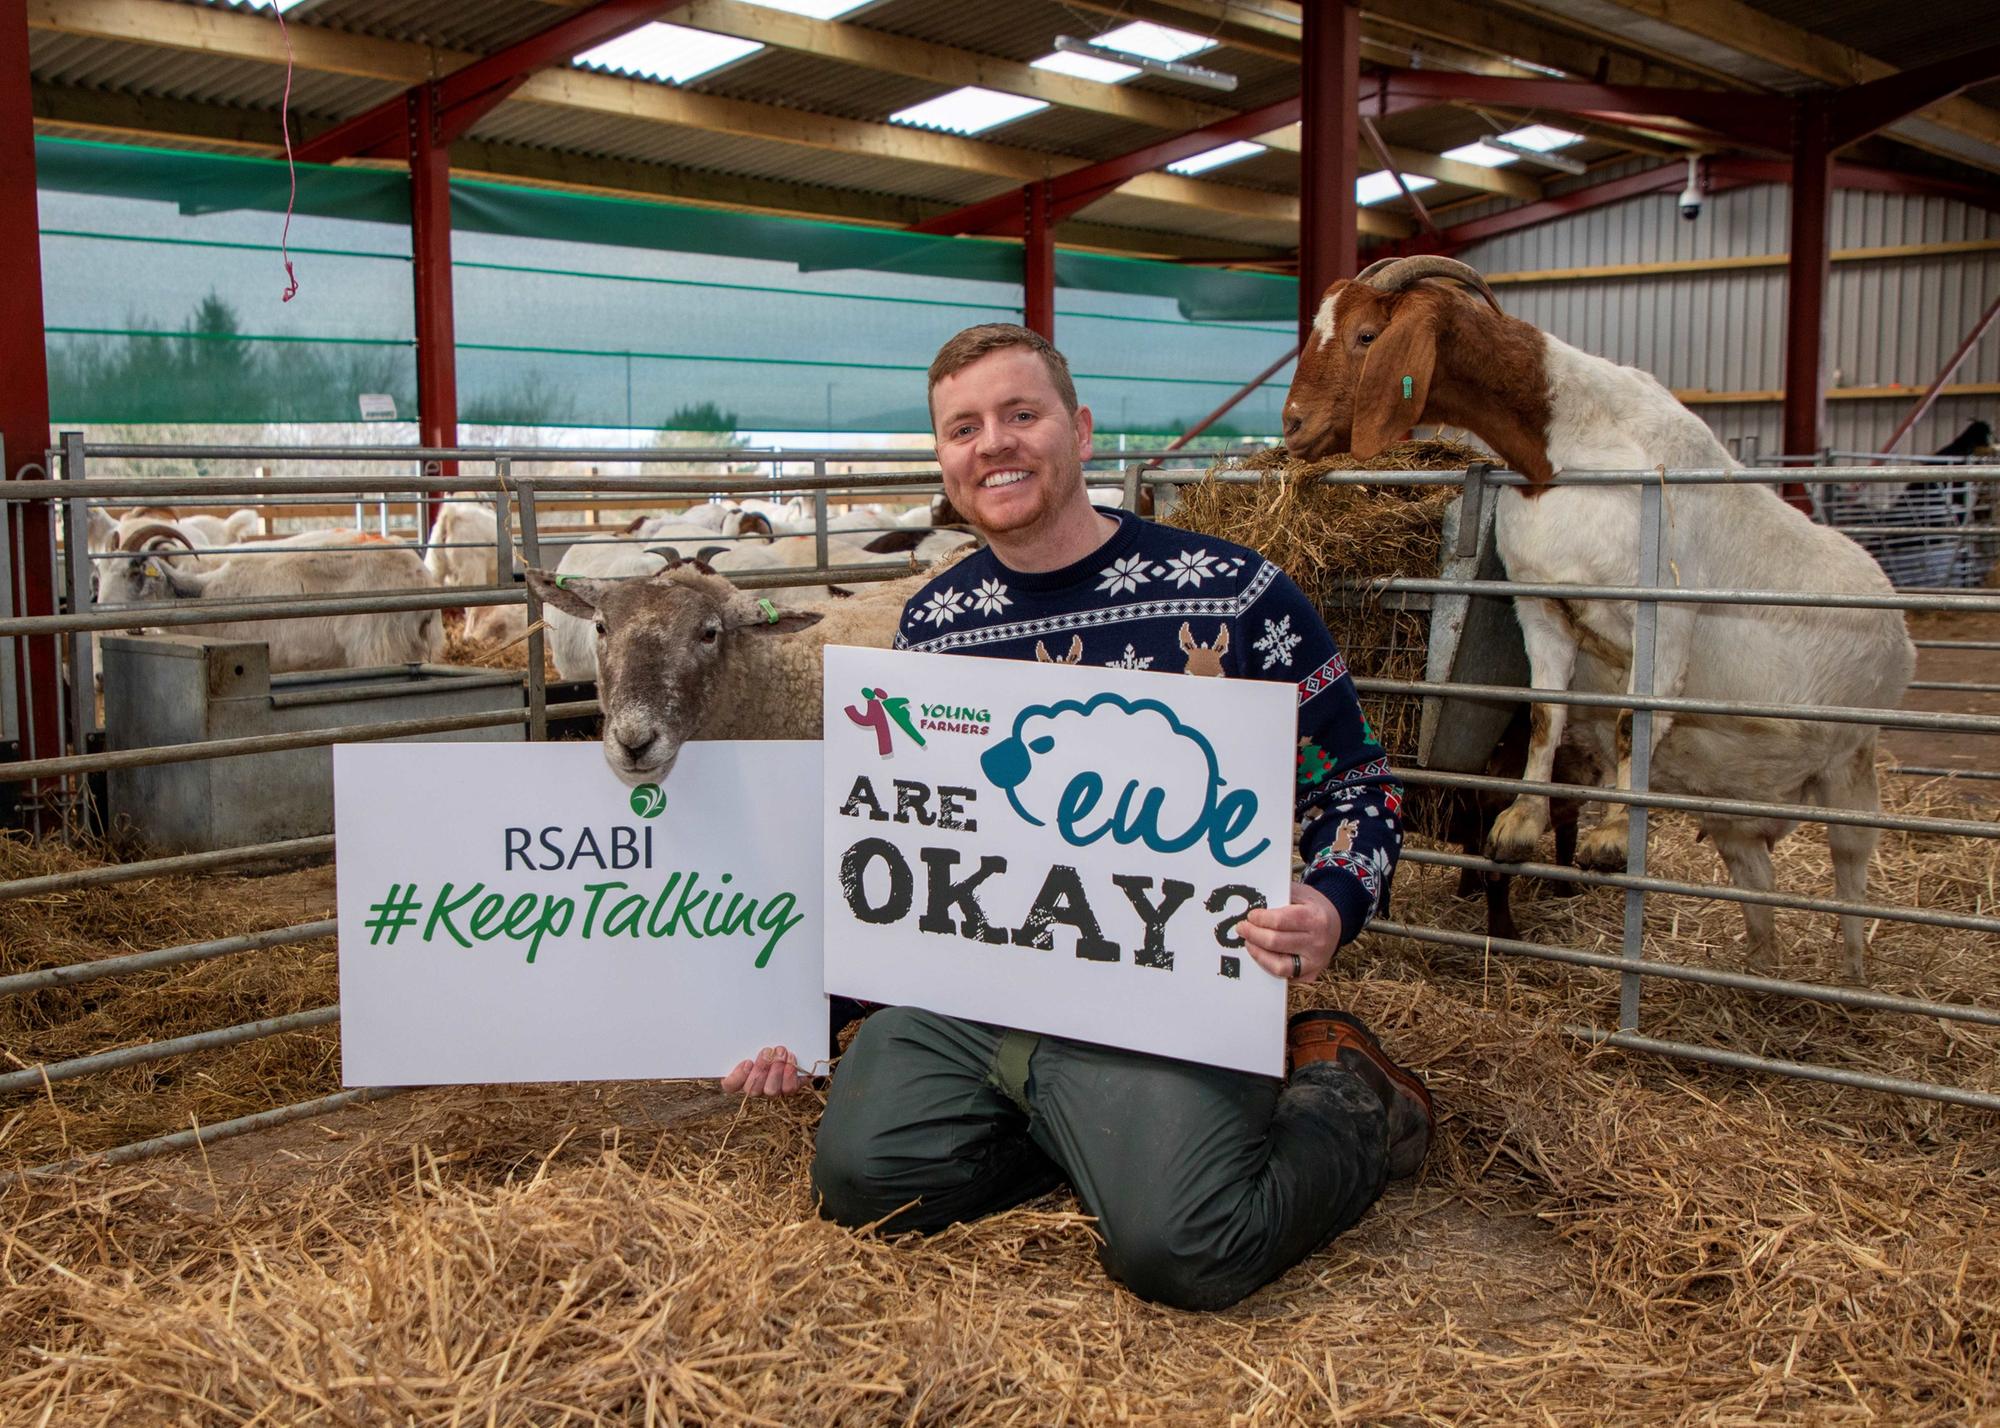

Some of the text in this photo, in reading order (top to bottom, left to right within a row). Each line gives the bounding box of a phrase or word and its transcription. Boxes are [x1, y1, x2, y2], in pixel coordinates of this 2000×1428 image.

[920, 703, 992, 723] YOUNG
[920, 719, 990, 736] FARMERS
[504, 825, 654, 871] RSABI
[839, 770, 1271, 868] ARE ewe
[364, 871, 805, 969] #KeepTalking
[839, 836, 1268, 979] OKAY?
